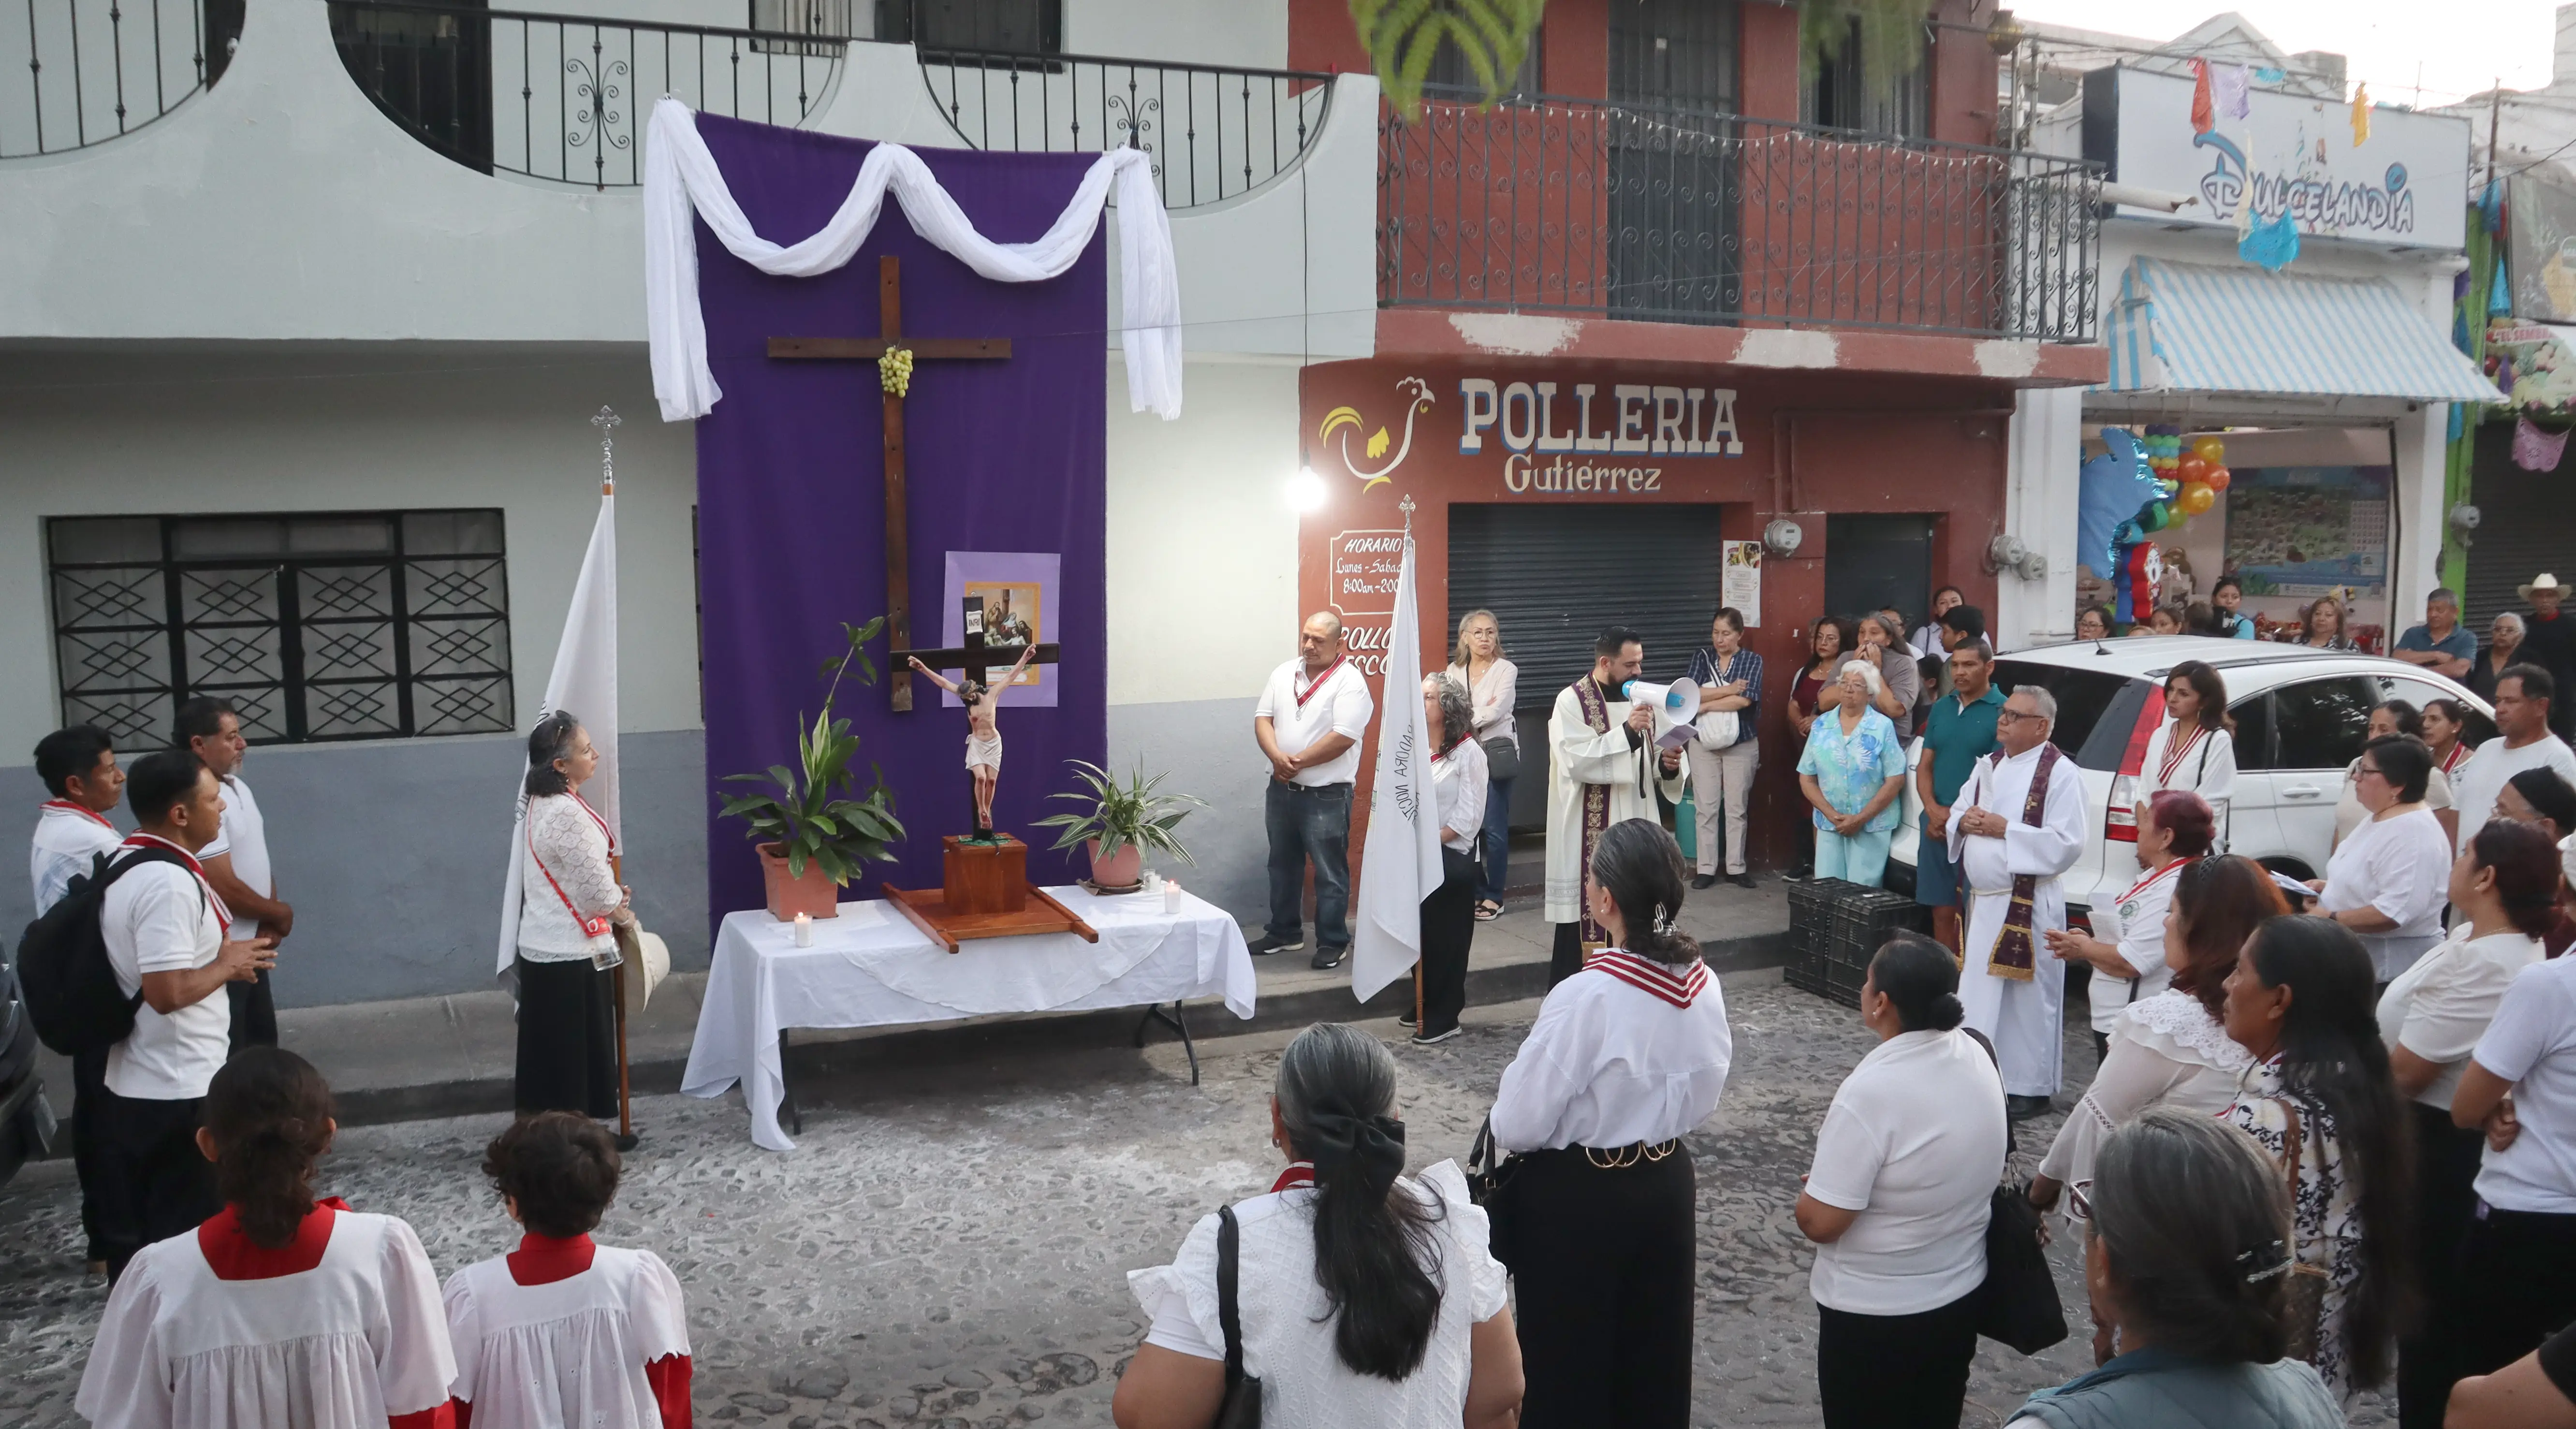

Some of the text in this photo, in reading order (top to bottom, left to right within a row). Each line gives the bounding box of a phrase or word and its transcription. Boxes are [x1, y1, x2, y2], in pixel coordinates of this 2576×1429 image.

[1459, 378, 1743, 458] POLLERIA
[1504, 453, 1662, 494] Gutiérrez
[1344, 537, 1403, 553] HORARIO
[1335, 557, 1362, 574] Lunes
[968, 618, 981, 627] INRI
